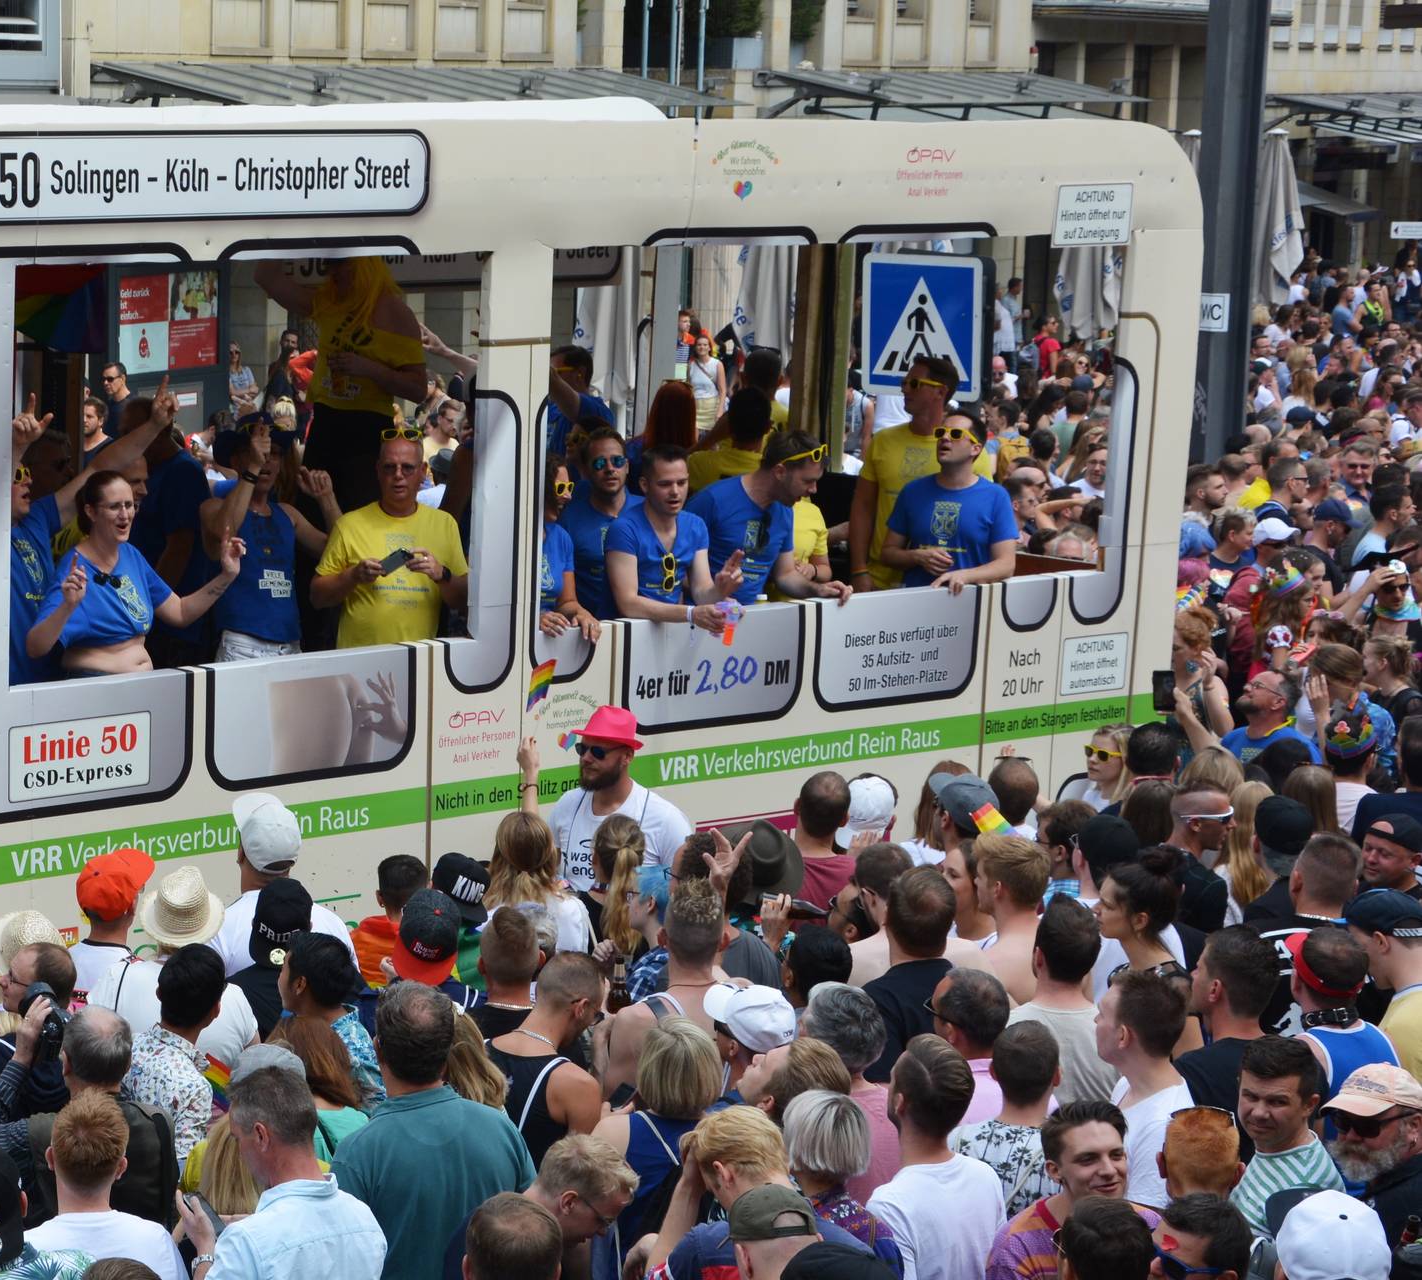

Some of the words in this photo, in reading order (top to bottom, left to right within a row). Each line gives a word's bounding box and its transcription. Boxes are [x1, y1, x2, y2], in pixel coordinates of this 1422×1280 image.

[0, 152, 40, 208] 50
[51, 160, 139, 203] Solingen
[166, 158, 209, 193] Köln
[235, 157, 349, 199] Christopher
[354, 156, 410, 190] Street
[1075, 190, 1114, 202] ACHTUNG
[1061, 209, 1086, 221] Hinten
[1088, 208, 1110, 220] öffnet
[1112, 209, 1126, 220] nur
[1063, 228, 1076, 239] auf
[1078, 227, 1119, 240] Zuneigung
[1201, 304, 1222, 320] WC
[844, 633, 876, 648] Dieser
[879, 630, 897, 644] Bus
[900, 626, 934, 643] verfügt
[938, 625, 958, 639] über
[1077, 640, 1114, 654] ACHTUNG
[862, 654, 874, 668] 35
[876, 651, 915, 666] Aufsitz-
[921, 648, 939, 661] und
[1009, 648, 1040, 668] Nach
[1070, 660, 1094, 672] Hinten
[1096, 657, 1118, 669] öffnet
[636, 674, 664, 700] 4er
[668, 670, 690, 696] für
[694, 655, 758, 695] 2,80
[764, 659, 790, 686] DM
[848, 678, 861, 692] 50
[864, 669, 948, 690] Im-Stehen-Plätze
[1002, 680, 1016, 697] 20
[1021, 678, 1044, 694] Uhr
[1069, 674, 1115, 689] automatisch
[985, 720, 1005, 735] Bitte
[1007, 719, 1018, 731] an
[1022, 716, 1038, 730] den
[1040, 711, 1078, 728] Stangen
[1080, 705, 1125, 722] festhalten
[24, 730, 90, 764] Linie
[101, 723, 137, 754] 50
[482, 729, 516, 744] Personen
[453, 753, 469, 764] Anal
[471, 749, 500, 762] Verkehr
[660, 756, 699, 782] VRR
[703, 734, 853, 775] Verkehrsverbund
[859, 732, 896, 756] Rein
[900, 728, 940, 750] Raus
[23, 763, 133, 789] CSD-Express
[435, 791, 469, 811] Nicht
[473, 789, 484, 805] in
[488, 787, 513, 803] den
[10, 845, 63, 876] VRR
[320, 804, 370, 832] Raus
[451, 875, 486, 904] KING
[259, 922, 300, 943] PRID
